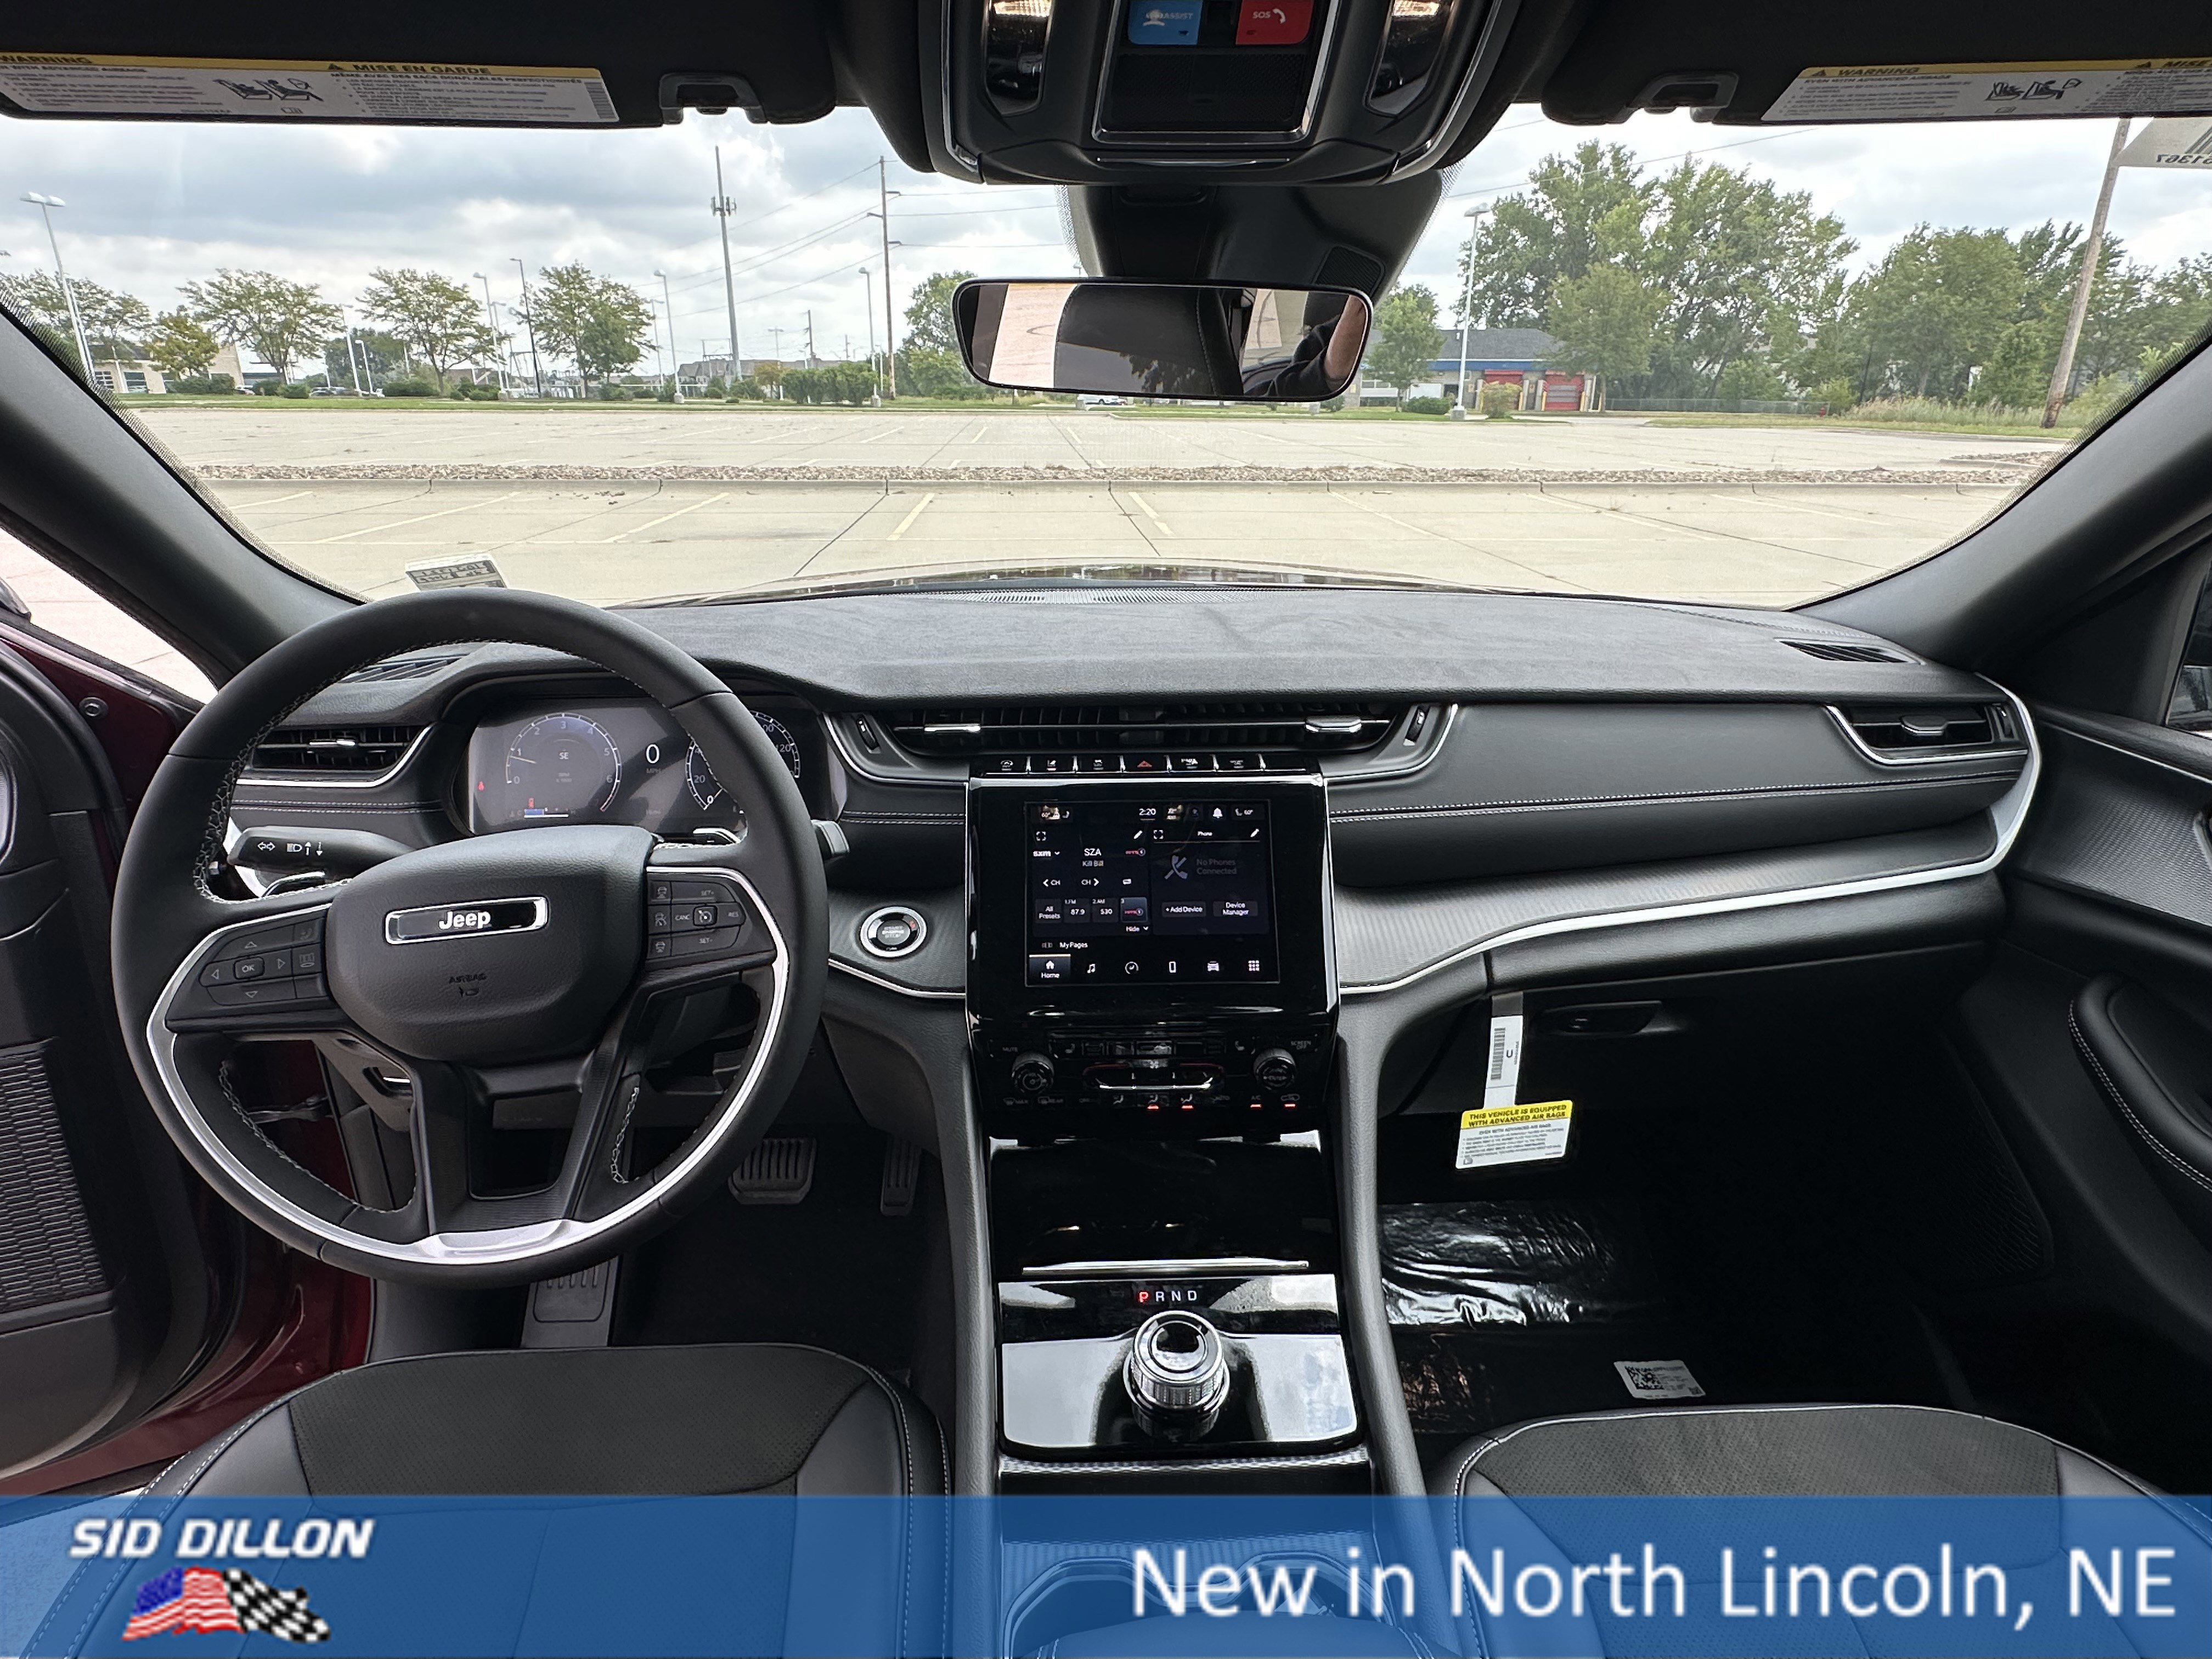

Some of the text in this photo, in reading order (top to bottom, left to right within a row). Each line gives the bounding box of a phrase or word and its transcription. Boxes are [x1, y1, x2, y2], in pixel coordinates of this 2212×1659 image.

[430, 66, 492, 74] GARDE
[1838, 67, 1920, 76] WARNING
[560, 721, 567, 729] 3
[534, 727, 540, 735] 2
[586, 727, 594, 735] 4
[517, 748, 522, 756] 1
[604, 748, 610, 756] 5
[646, 743, 660, 764] 0
[514, 776, 520, 785] 0
[606, 775, 613, 783] 6
[693, 775, 706, 783] 20
[707, 795, 714, 804] 0
[439, 911, 491, 930] Jeep
[1070, 941, 1088, 949] Pages
[241, 964, 255, 973] OK
[1488, 1109, 1520, 1118] VEHICLE
[1530, 1104, 1567, 1114] EQUIPPED
[1468, 1119, 1488, 1127] WITH
[1489, 1115, 1531, 1125] ADVANCED
[1138, 1290, 1197, 1303] P R N D
